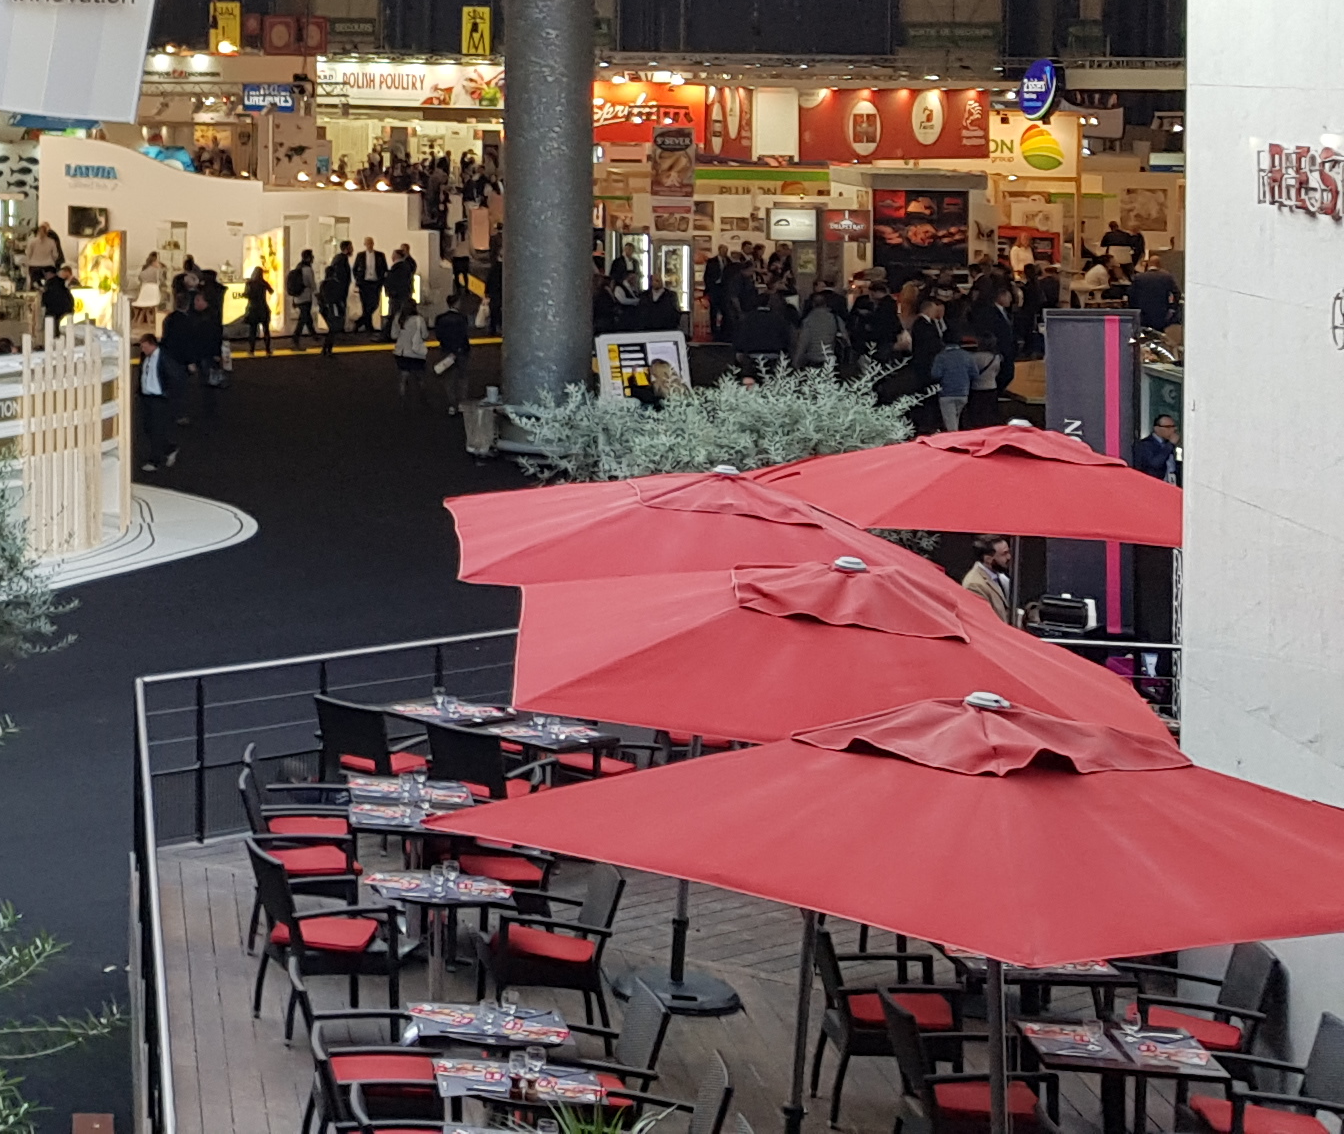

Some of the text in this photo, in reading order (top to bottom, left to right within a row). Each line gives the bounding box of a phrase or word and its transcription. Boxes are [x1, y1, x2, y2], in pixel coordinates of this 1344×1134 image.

[342, 72, 426, 91] POLISH POULTRY
[64, 163, 118, 180] LATVIA
